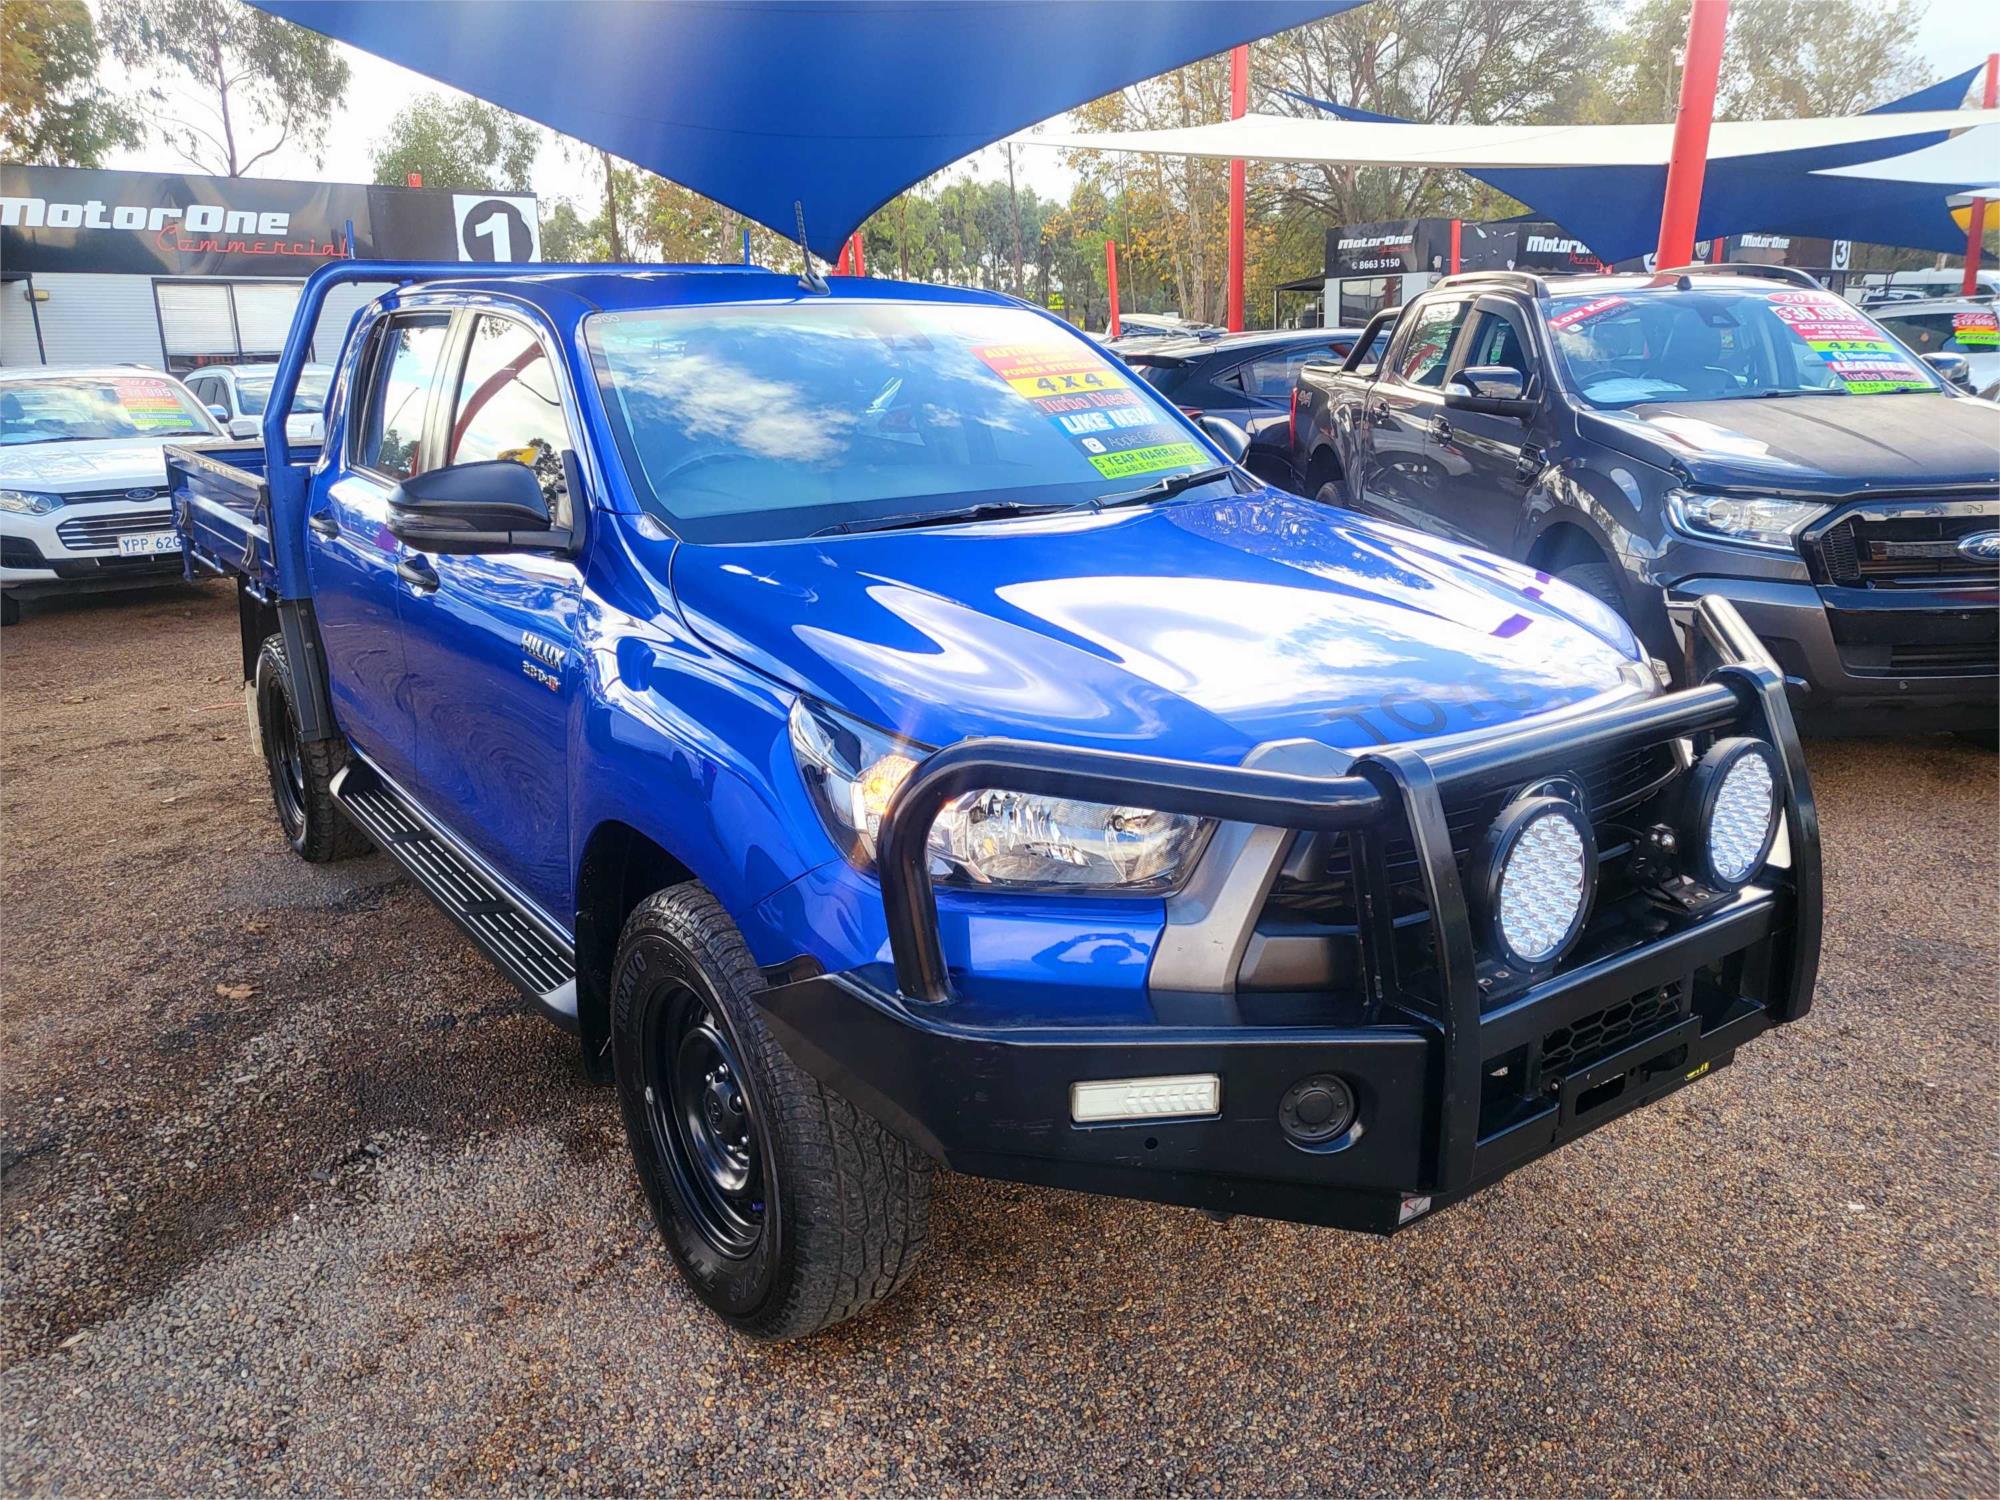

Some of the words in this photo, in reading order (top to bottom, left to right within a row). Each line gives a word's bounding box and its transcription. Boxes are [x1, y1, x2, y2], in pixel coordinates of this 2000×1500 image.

[0, 196, 290, 235] MotorOne
[155, 224, 350, 262] Commercial
[475, 213, 512, 262] 1
[1337, 235, 1414, 250] MotorOne
[1740, 235, 1790, 249] MotorOne
[1359, 260, 1378, 270] 8663
[1380, 258, 1401, 268] 5150
[1836, 241, 1847, 264] 3
[1033, 393, 1089, 413] Turbo
[1086, 388, 1143, 408] Diesel
[1107, 407, 1158, 428] NEW
[1094, 459, 1106, 469] 5
[1105, 453, 1137, 467] YEAR
[1136, 443, 1200, 461] WARRANTY
[123, 538, 149, 552] YPP
[521, 631, 566, 672] HILUX
